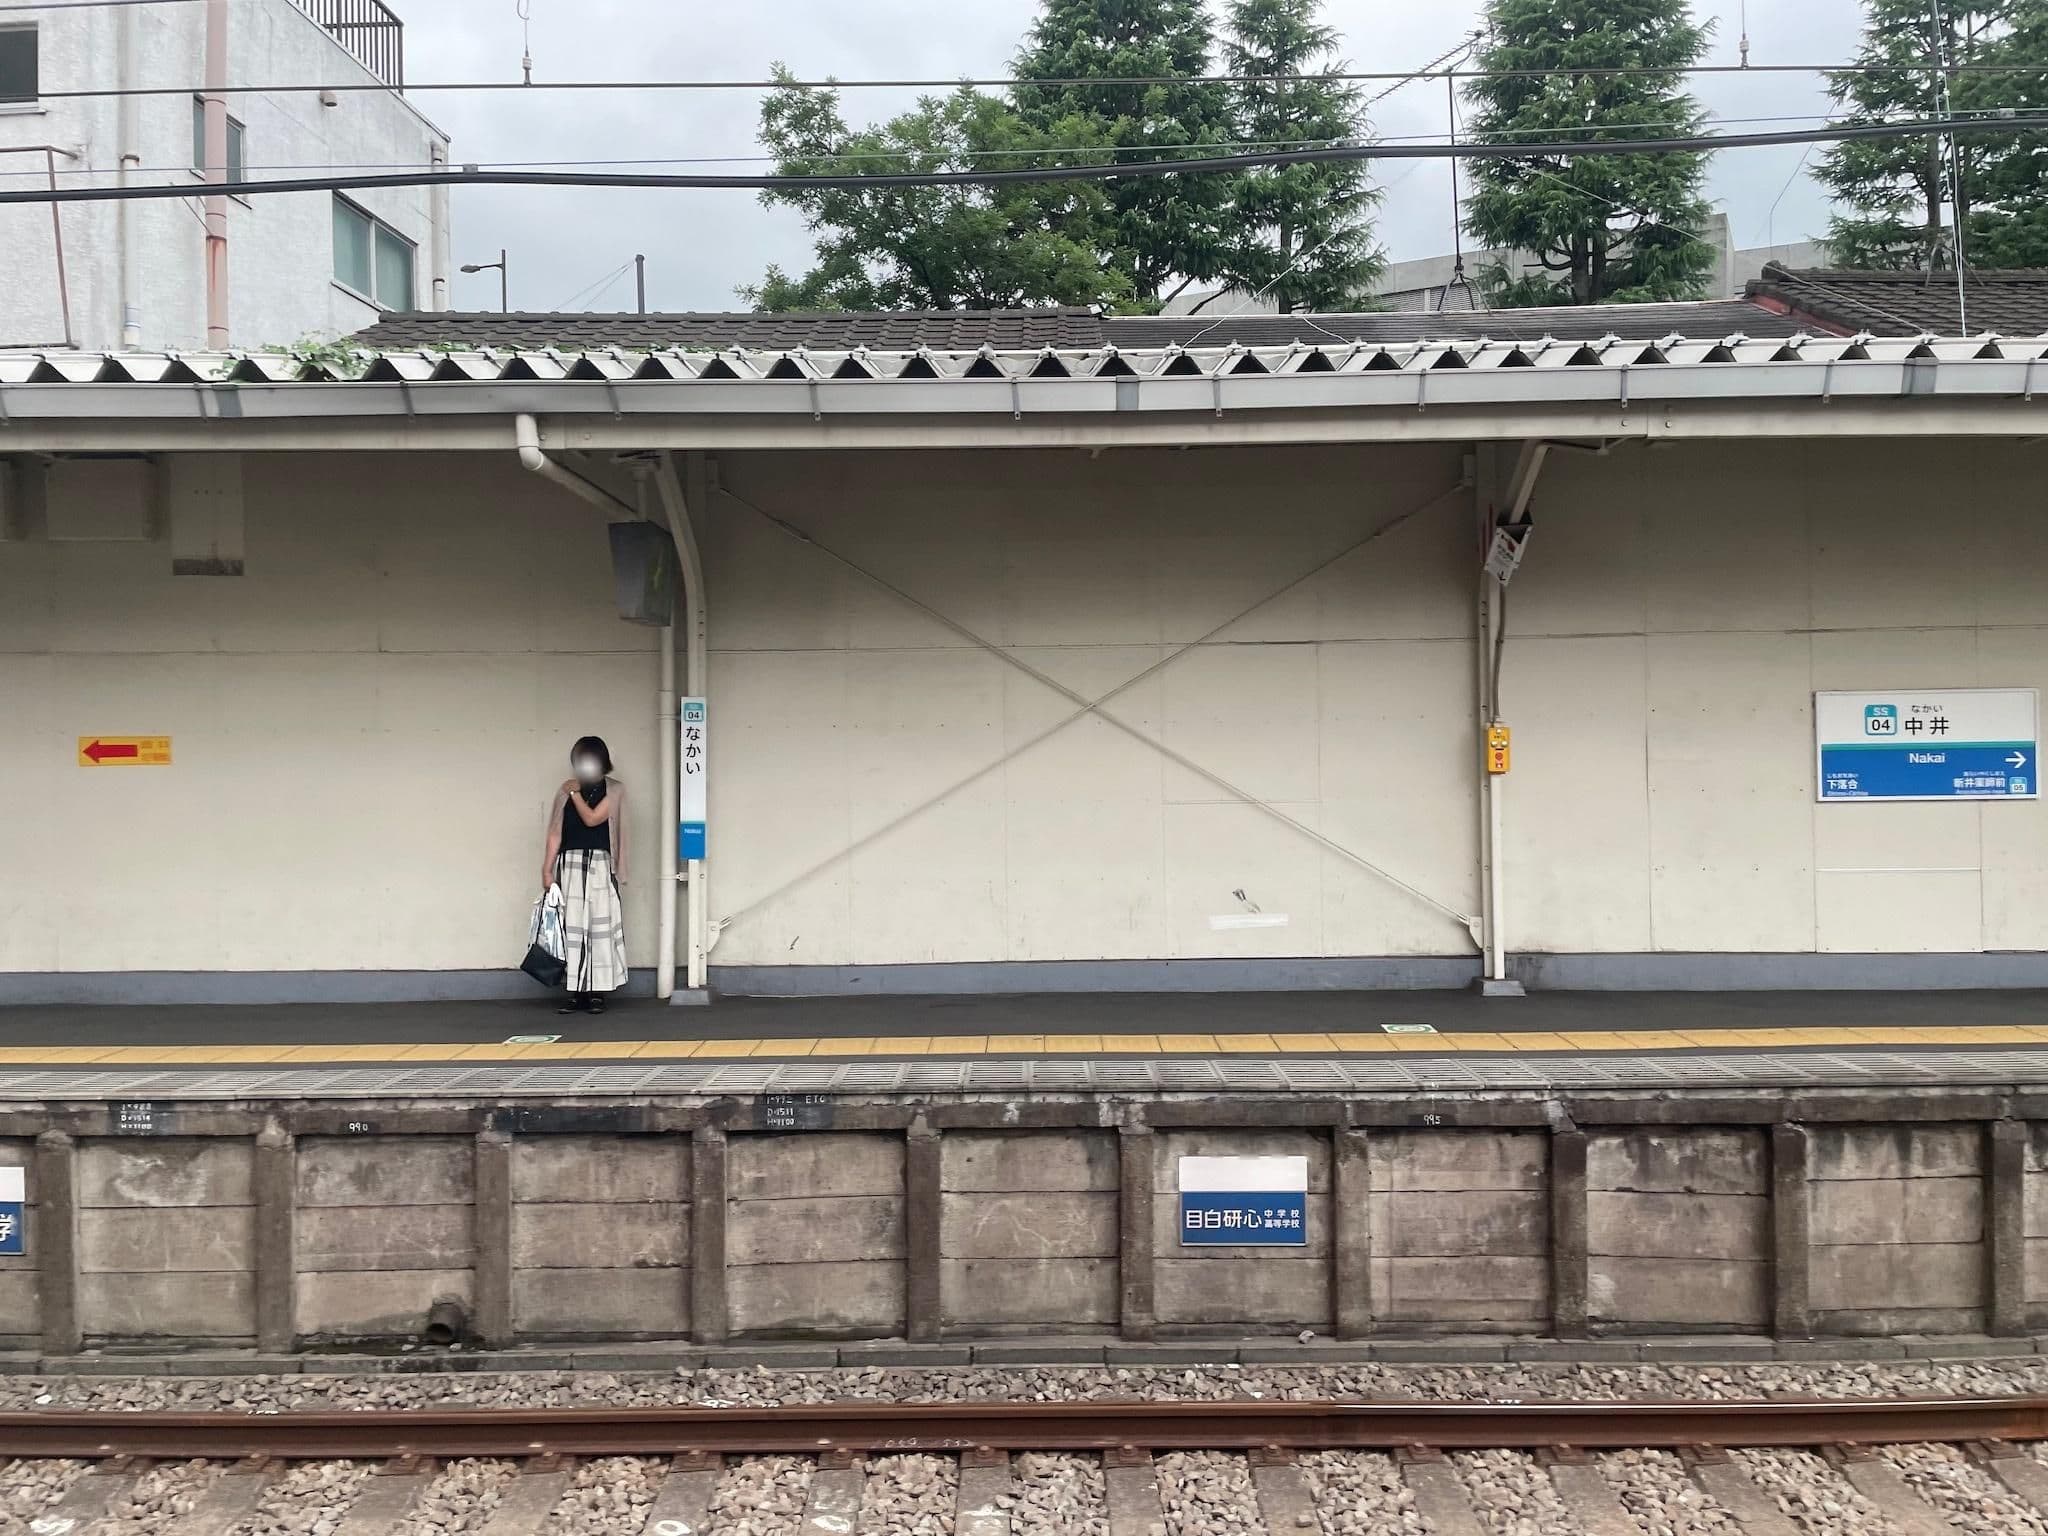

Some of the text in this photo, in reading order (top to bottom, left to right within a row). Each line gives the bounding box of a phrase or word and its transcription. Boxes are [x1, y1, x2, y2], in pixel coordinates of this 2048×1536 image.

[1872, 707, 1889, 716] SS
[1911, 704, 1944, 713] なかい
[687, 711, 700, 719] 04
[1871, 719, 1890, 731] 04
[1904, 716, 1950, 735] 中井
[685, 726, 701, 775] なかい
[1909, 752, 1946, 763] Nakai
[1423, 1114, 1441, 1126] 995
[349, 1122, 369, 1132] 990
[1186, 1209, 1300, 1228] 目白研心 中学校
[1264, 1219, 1300, 1228] 高等学校
